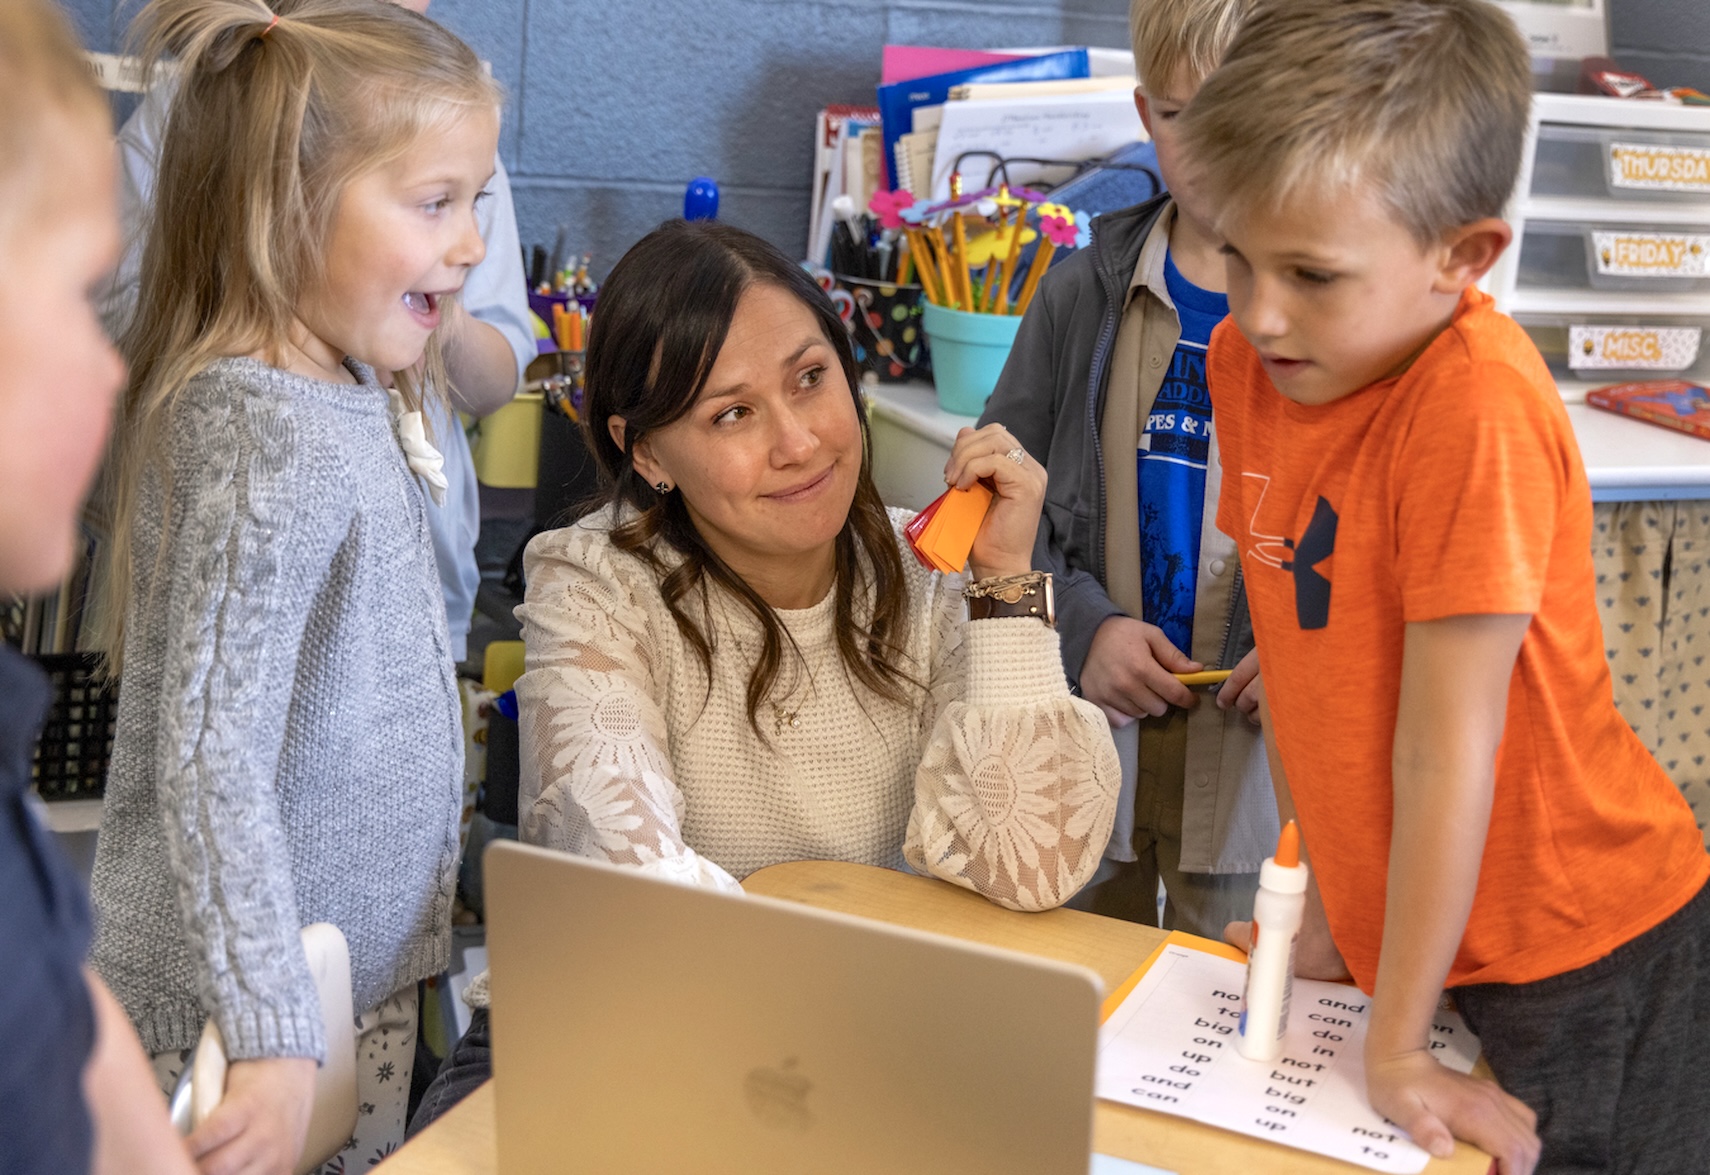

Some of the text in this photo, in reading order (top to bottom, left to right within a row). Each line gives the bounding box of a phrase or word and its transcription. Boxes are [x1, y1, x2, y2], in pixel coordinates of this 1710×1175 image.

[1617, 242, 1684, 266] FRIDAY
[1181, 416, 1198, 435] &
[1217, 1007, 1241, 1019] to
[1318, 998, 1365, 1013] and
[1194, 1017, 1233, 1035] big
[1308, 1013, 1352, 1028] can
[1193, 1037, 1222, 1049] on
[1312, 1030, 1343, 1042] do
[1182, 1050, 1211, 1064] up
[1312, 1044, 1334, 1057] in
[1169, 1064, 1200, 1077] do
[1281, 1056, 1326, 1072] not
[1141, 1073, 1191, 1091] and
[1269, 1069, 1317, 1088] but
[1131, 1087, 1179, 1104] can
[1265, 1086, 1307, 1105] big
[1266, 1105, 1296, 1118] on
[1255, 1118, 1287, 1132] up
[1352, 1127, 1399, 1143] not
[1361, 1145, 1389, 1159] to
